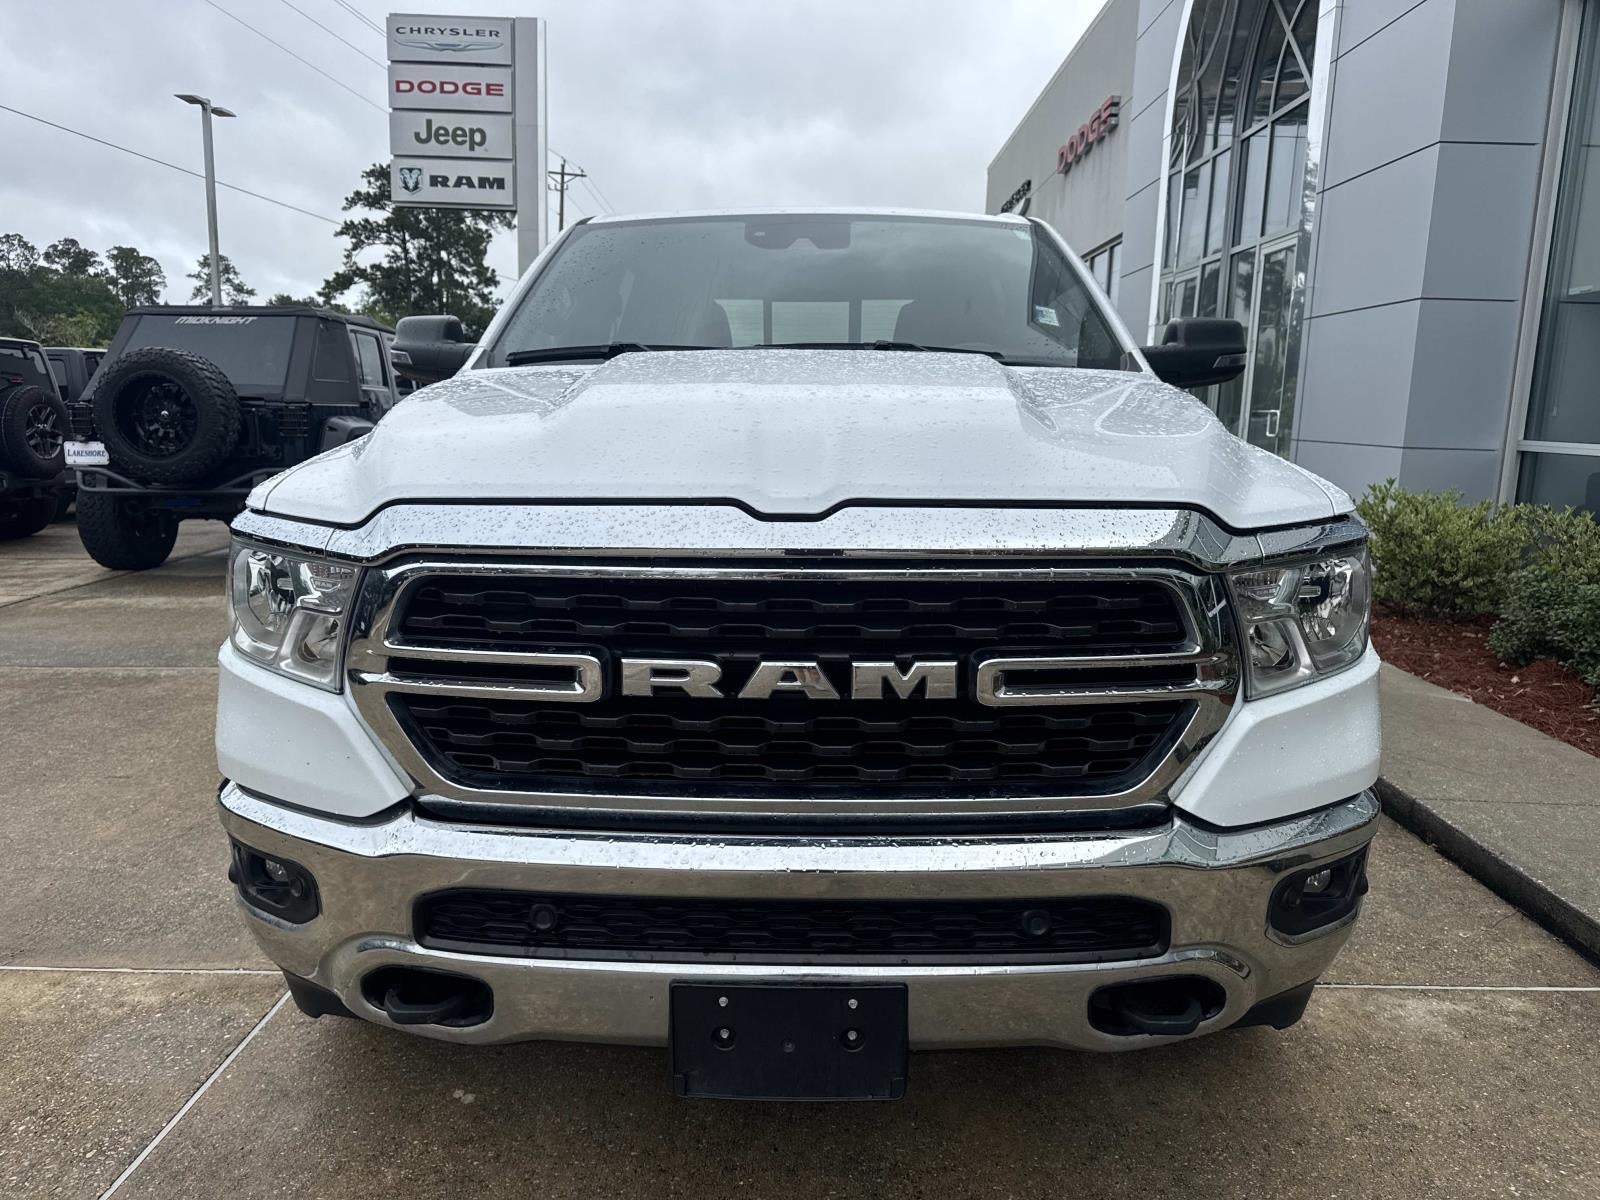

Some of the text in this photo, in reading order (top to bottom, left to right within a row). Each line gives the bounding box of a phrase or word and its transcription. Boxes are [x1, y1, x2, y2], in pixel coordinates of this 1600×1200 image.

[395, 26, 500, 38] CHRYSLER
[395, 79, 504, 97] DODGE
[414, 118, 487, 152] Jeep
[1056, 95, 1121, 174] DODGE
[429, 174, 505, 190] RAM
[67, 449, 106, 457] LAKESHORE
[621, 658, 959, 699] RAM
